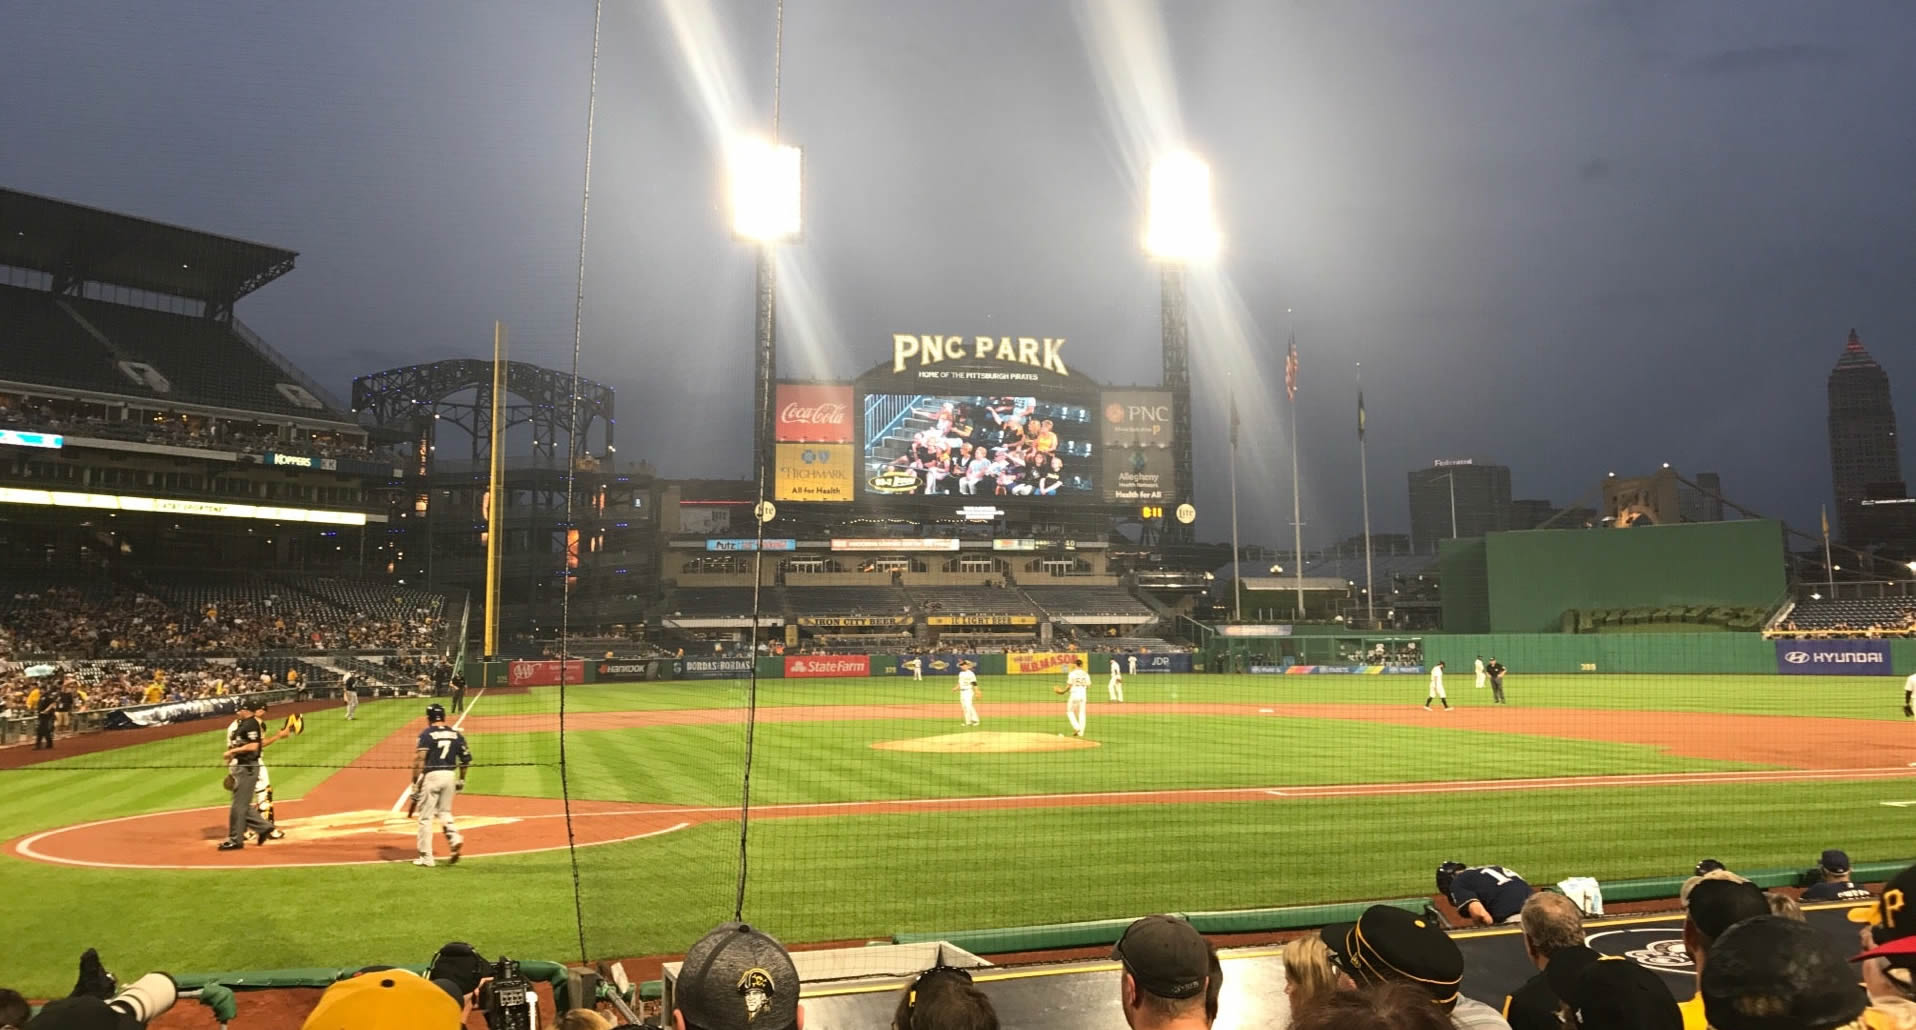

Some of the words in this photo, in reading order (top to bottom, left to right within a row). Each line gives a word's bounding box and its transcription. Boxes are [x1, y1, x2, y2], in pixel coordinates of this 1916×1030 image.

[892, 334, 967, 374] PNC
[975, 336, 1070, 377] PARK
[918, 371, 940, 379] HOME
[940, 371, 950, 379] OF
[951, 371, 965, 379] THE
[966, 372, 1009, 381] PITTSBURGH
[1010, 373, 1039, 381] PIRATES
[1127, 406, 1169, 421] PNC
[274, 453, 312, 467] KOPPERS
[1118, 472, 1159, 482] Allegheny
[792, 487, 802, 495] All
[803, 487, 815, 495] for
[816, 487, 840, 495] Health
[816, 617, 840, 626] IRON
[843, 617, 865, 626] CITY
[869, 616, 896, 626] BEER
[962, 616, 990, 625] LIGHT
[1813, 652, 1884, 663] HYUNDAI
[686, 661, 717, 671] BORDAS
[720, 660, 751, 670] BORDAS
[437, 740, 452, 759] 7
[1883, 889, 1905, 928] P
